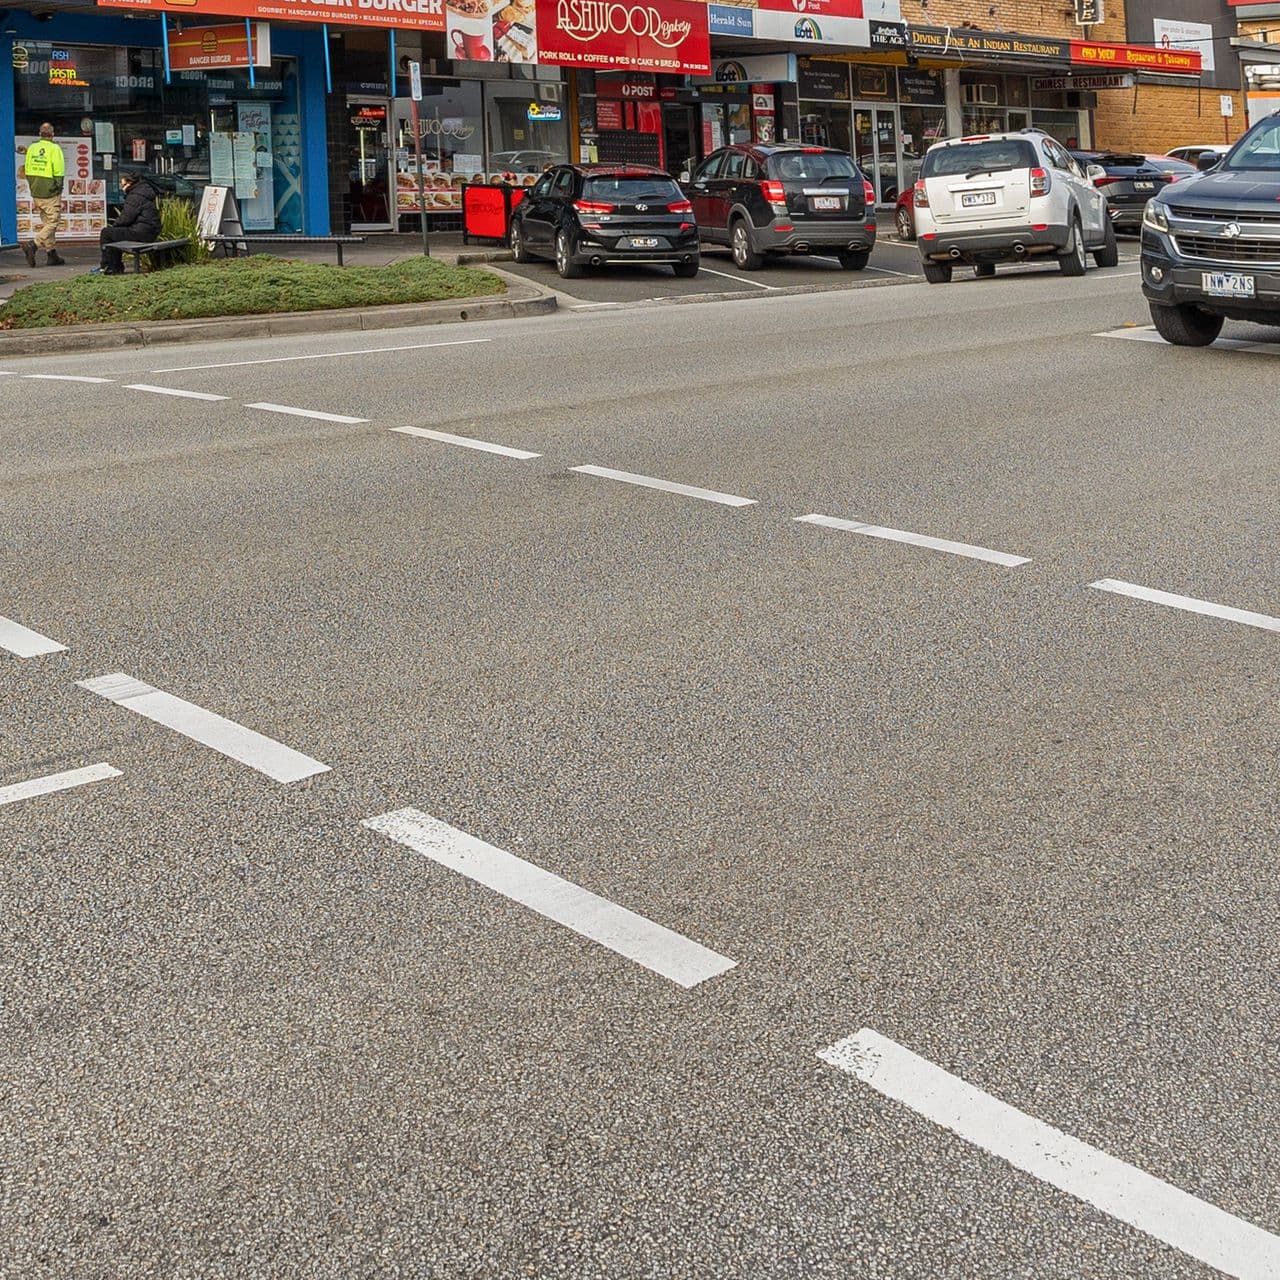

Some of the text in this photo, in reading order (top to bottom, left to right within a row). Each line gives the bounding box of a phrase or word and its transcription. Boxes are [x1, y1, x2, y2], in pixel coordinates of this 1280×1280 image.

[332, 11, 358, 20] BURGERS
[418, 18, 444, 27] SPECIALS
[710, 13, 753, 28] Herald Sun
[661, 18, 691, 40] Bakery
[871, 34, 905, 45] THE AGE
[189, 56, 210, 65] BANGER
[211, 55, 232, 64] BURGER
[539, 50, 558, 60] PORK
[558, 51, 576, 62] ROLL
[583, 53, 609, 64] COFFEE
[615, 55, 630, 65] PIES
[636, 57, 654, 66] CAKE
[660, 59, 680, 68] BREAD
[49, 67, 77, 79] PASTA
[1035, 75, 1124, 89] CHINESE RESTAURANT
[631, 85, 654, 97] POST
